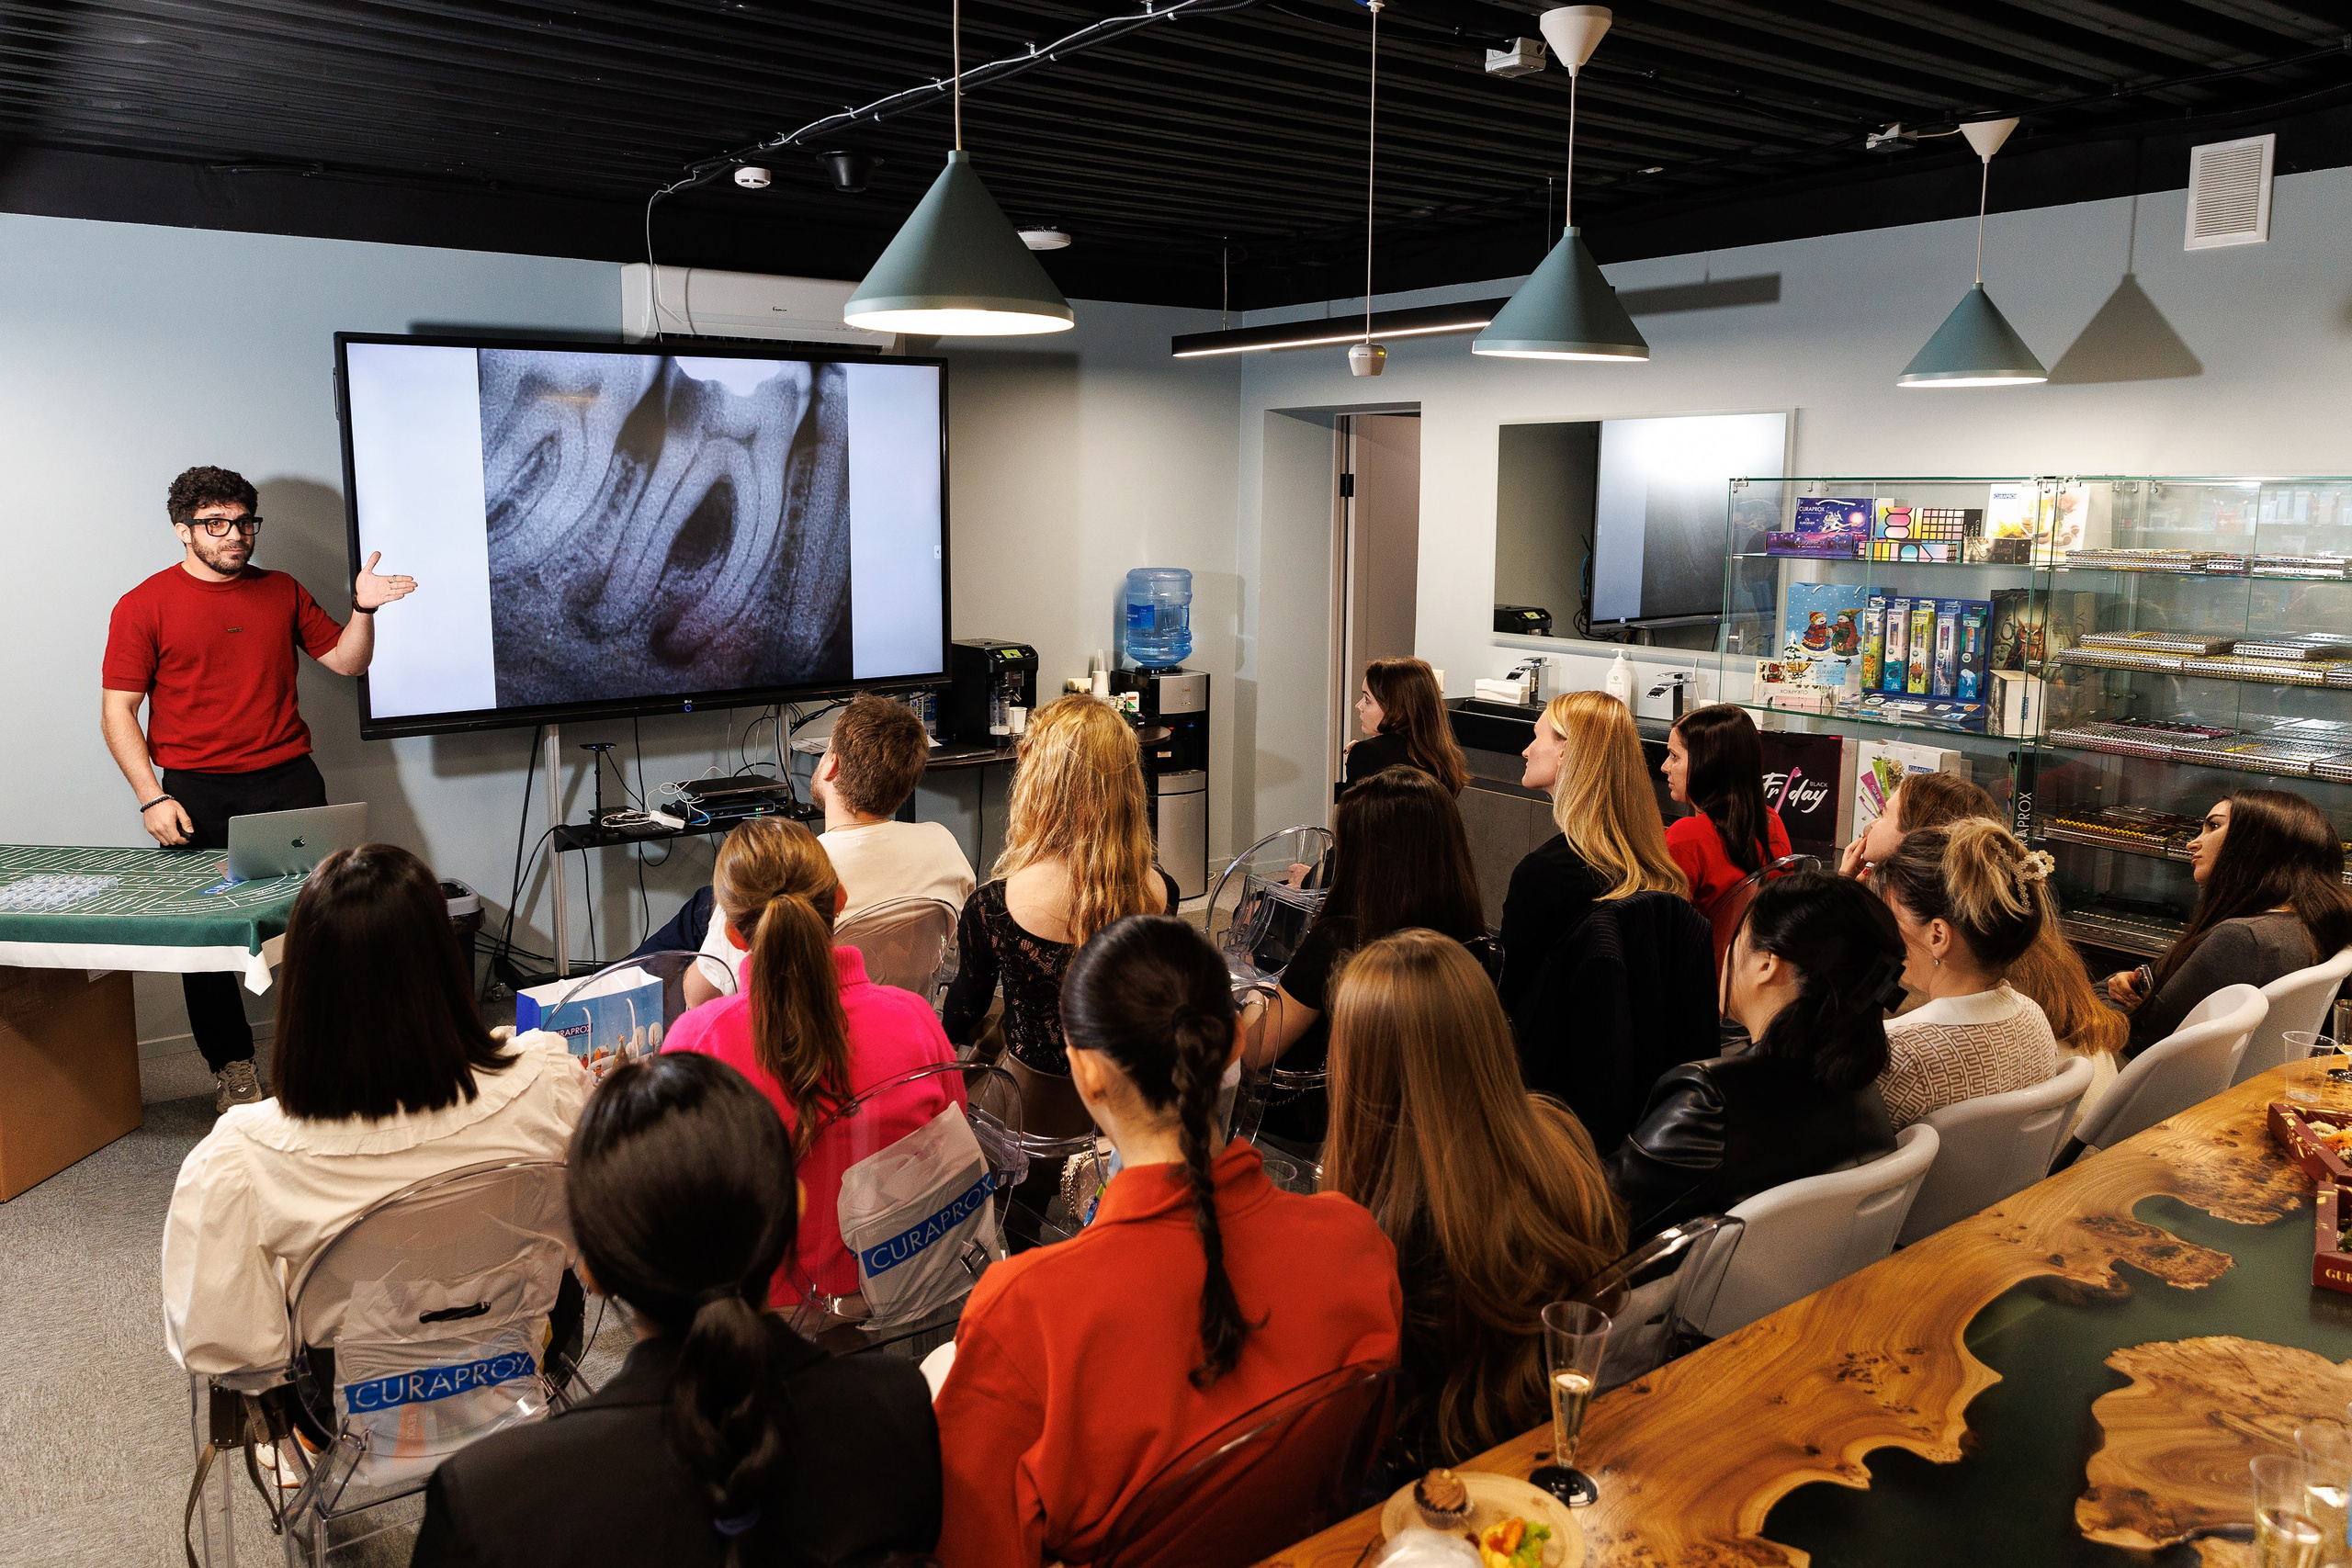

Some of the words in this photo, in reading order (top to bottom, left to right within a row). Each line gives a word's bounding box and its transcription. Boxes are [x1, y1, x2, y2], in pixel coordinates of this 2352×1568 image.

[2015, 792, 2032, 846] RAPROX
[558, 1025, 591, 1037] RAPRO
[870, 1174, 993, 1269] CURAPROX
[356, 1355, 531, 1408] CURAPROX
